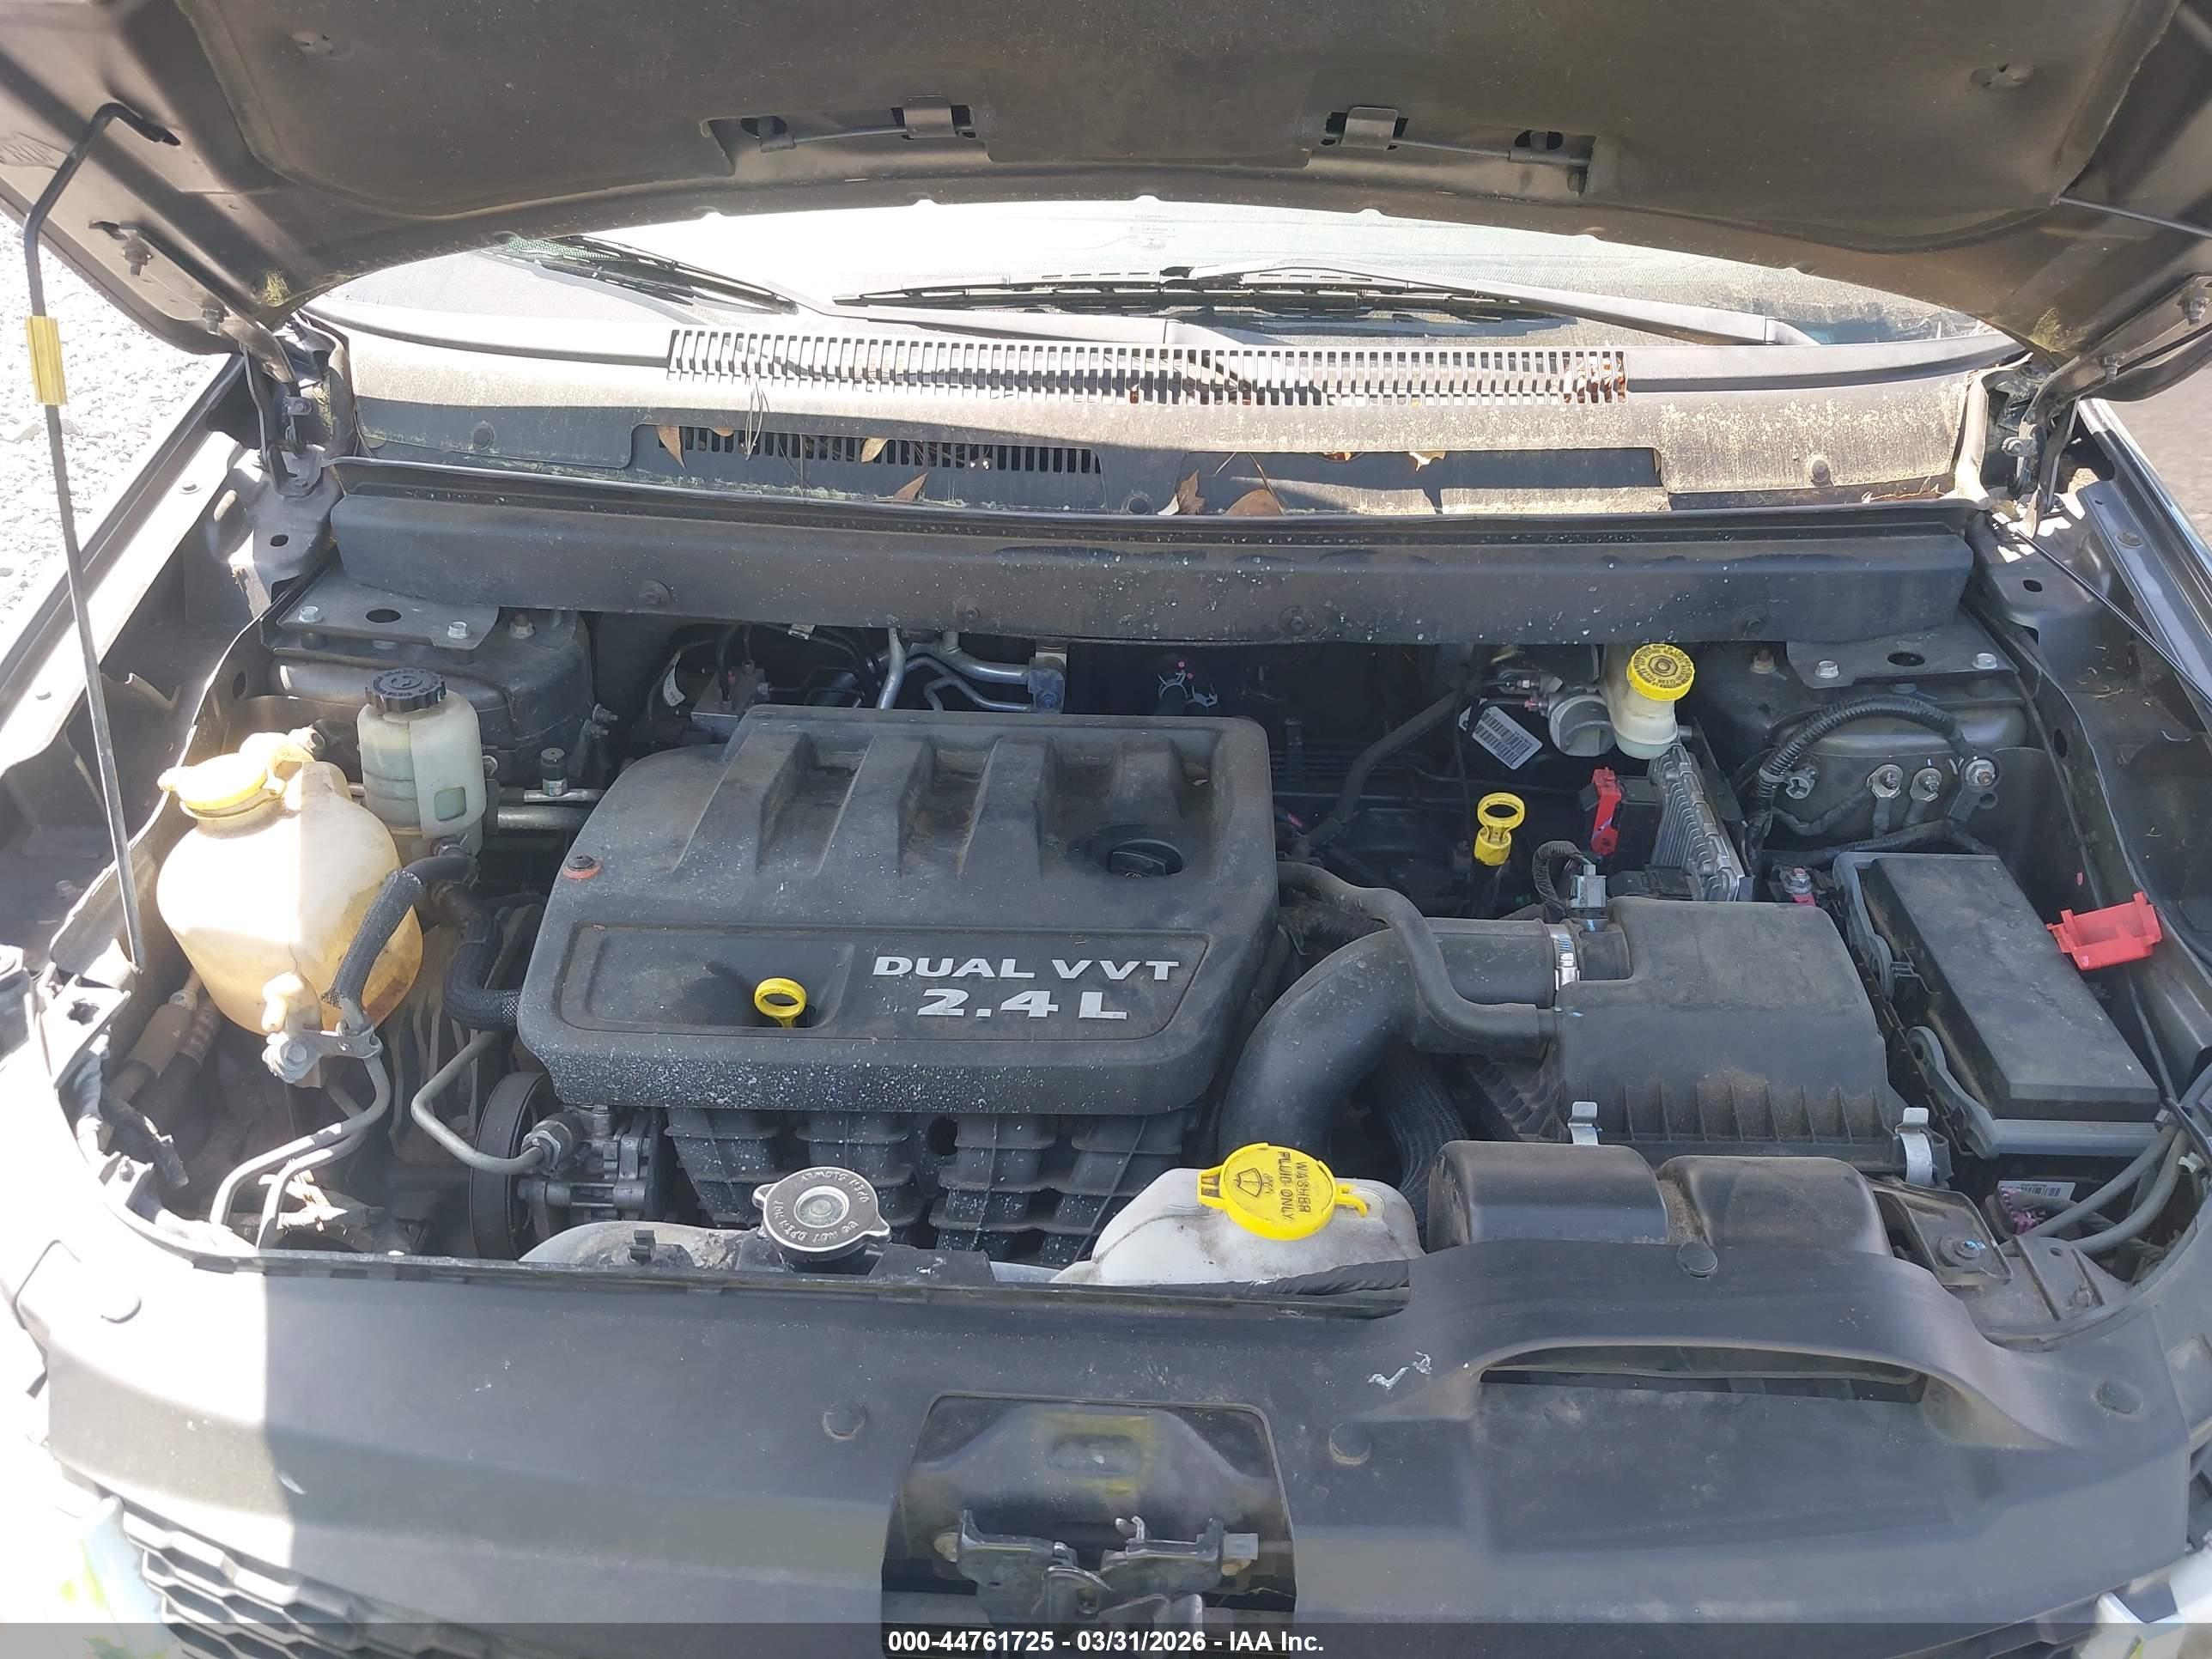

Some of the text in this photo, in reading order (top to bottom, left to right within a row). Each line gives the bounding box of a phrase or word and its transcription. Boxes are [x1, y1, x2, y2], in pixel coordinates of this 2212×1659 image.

[872, 956, 1180, 981] DUAL VVT
[917, 988, 1059, 1018] 2.4
[800, 1170, 870, 1203] OPEN SLOWLY
[1278, 1151, 1294, 1220] FLUID ONLY
[1296, 1161, 1311, 1212] WASHER
[774, 1200, 860, 1243] DO NOT OPEN HOT
